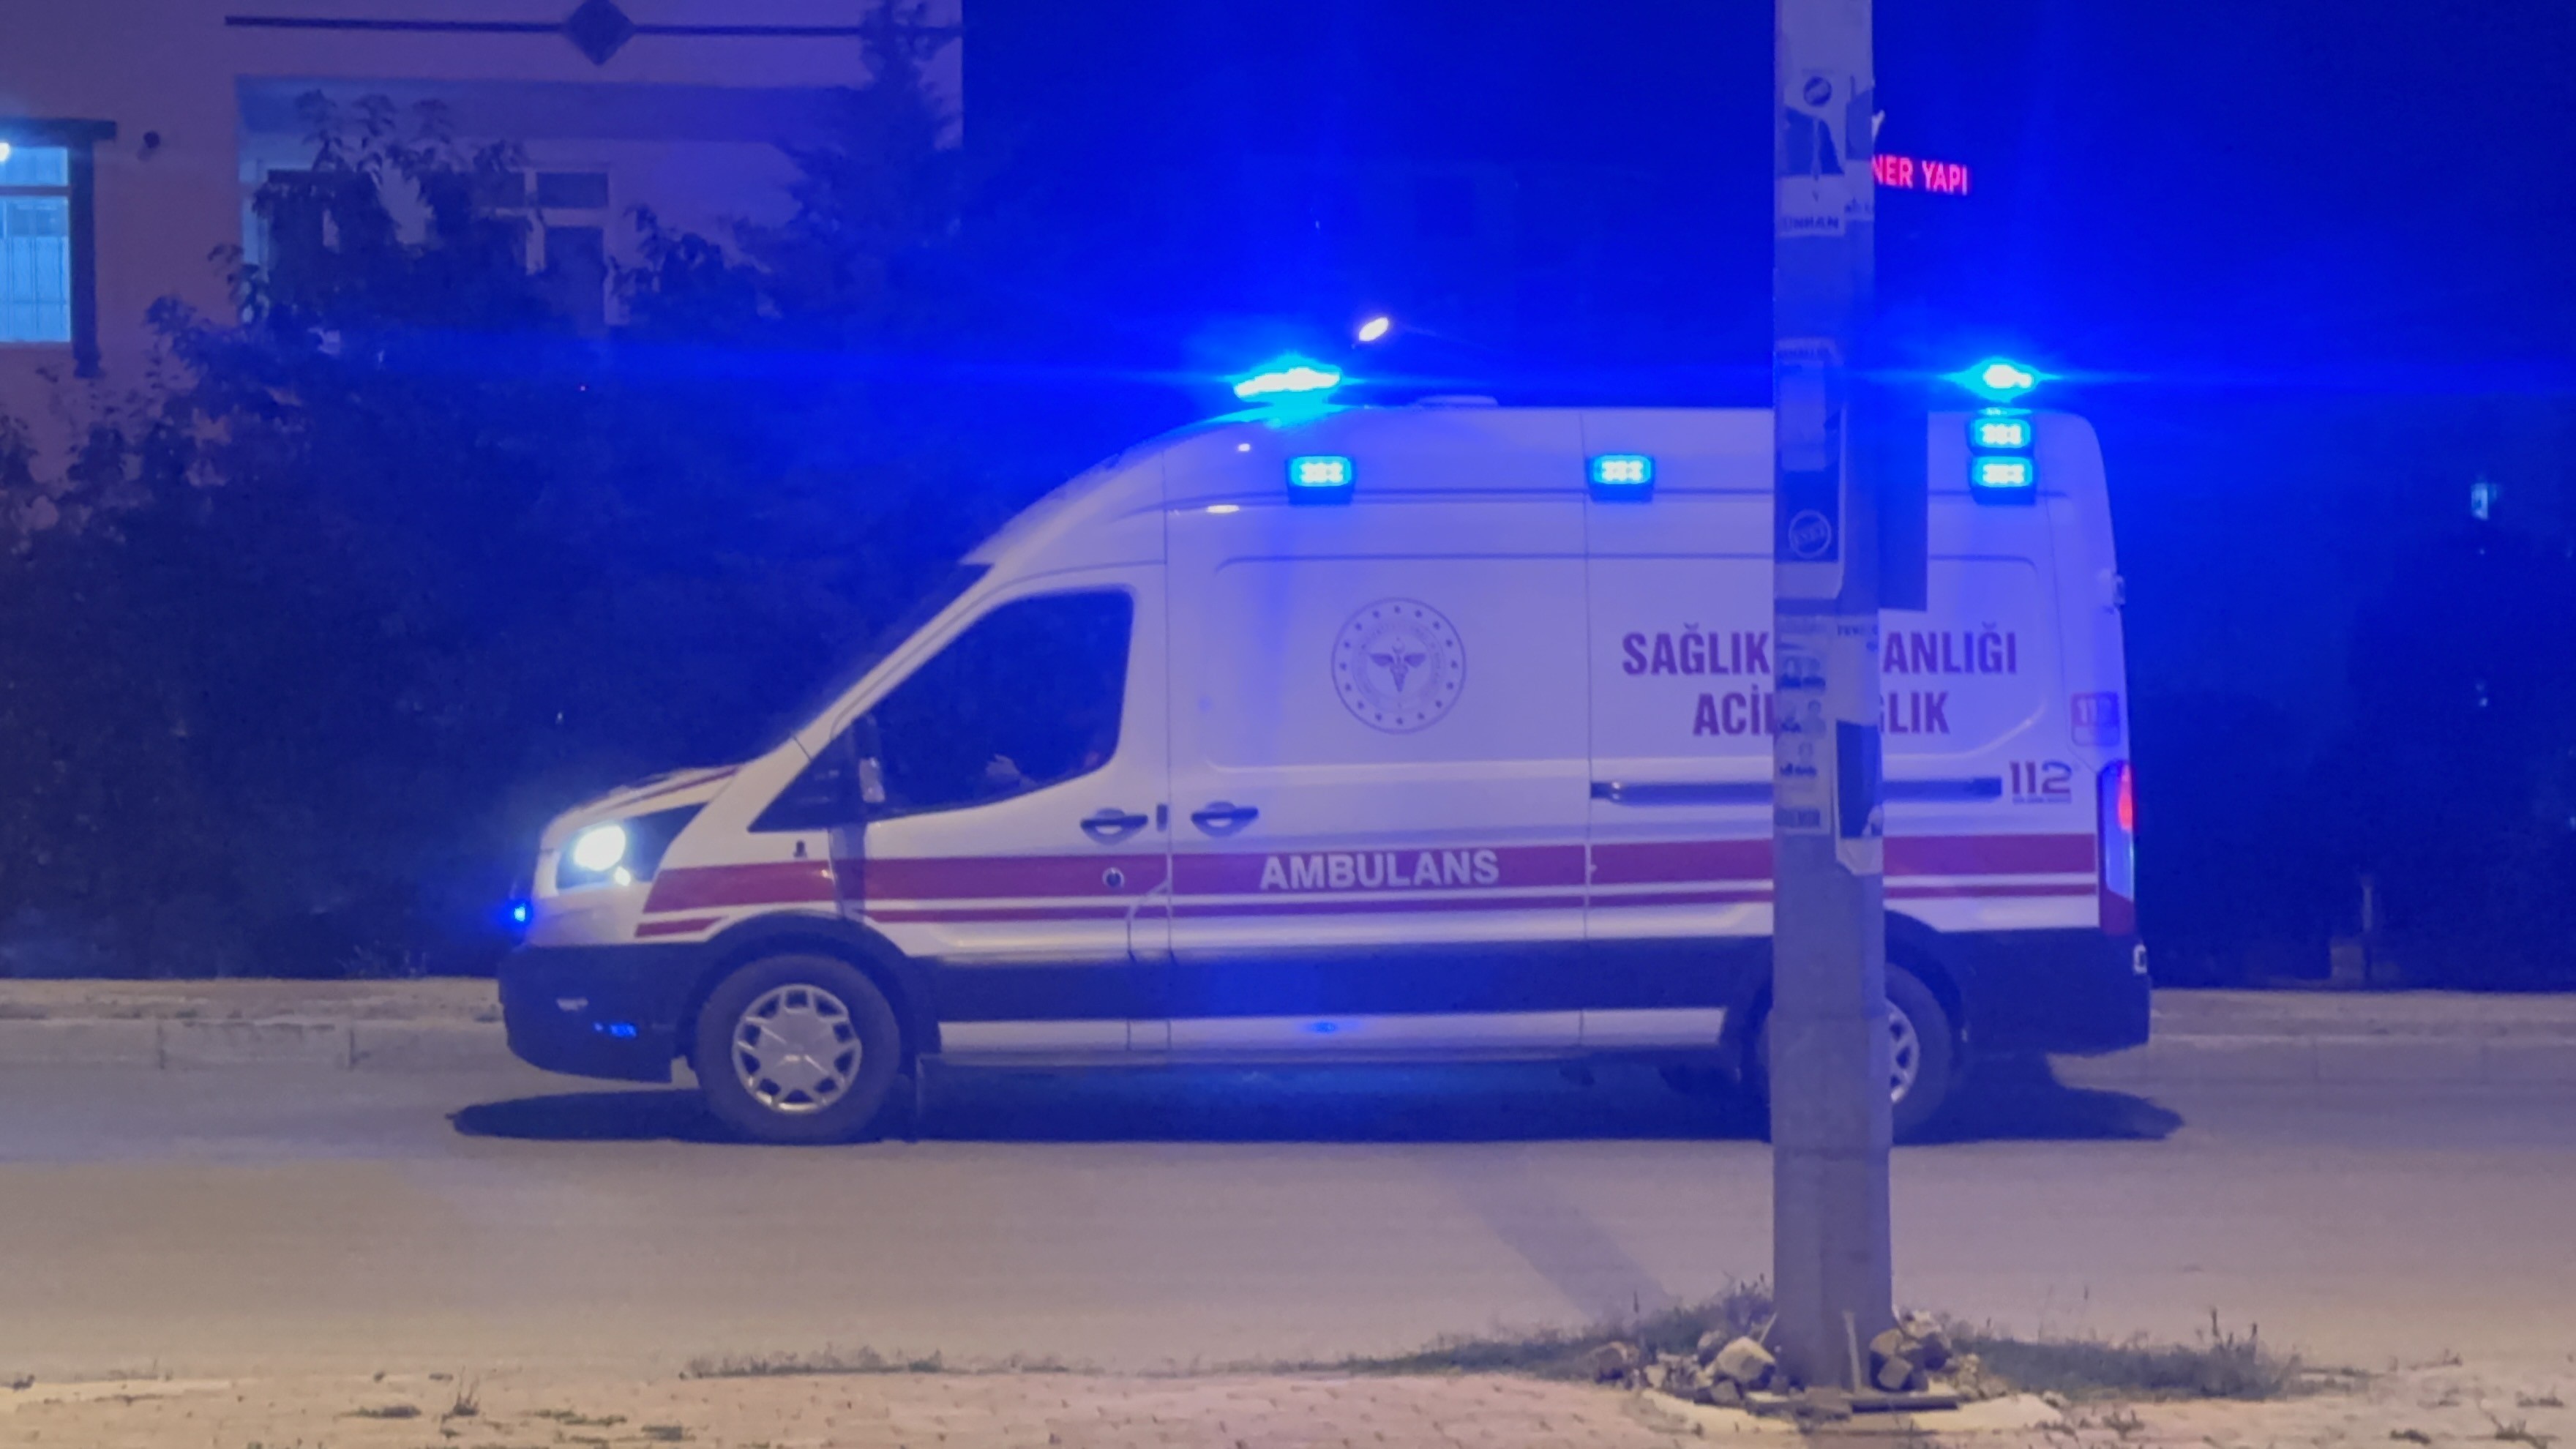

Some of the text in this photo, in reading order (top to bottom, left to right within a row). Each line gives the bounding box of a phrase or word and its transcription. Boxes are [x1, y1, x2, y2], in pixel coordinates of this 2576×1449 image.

[1921, 160, 1968, 196] YAPI
[1622, 621, 2017, 675] SAĞLIK ANLIĞI
[1880, 691, 1950, 734] LIK
[2010, 760, 2073, 795] 112
[1259, 849, 1500, 891] AMBULANS
